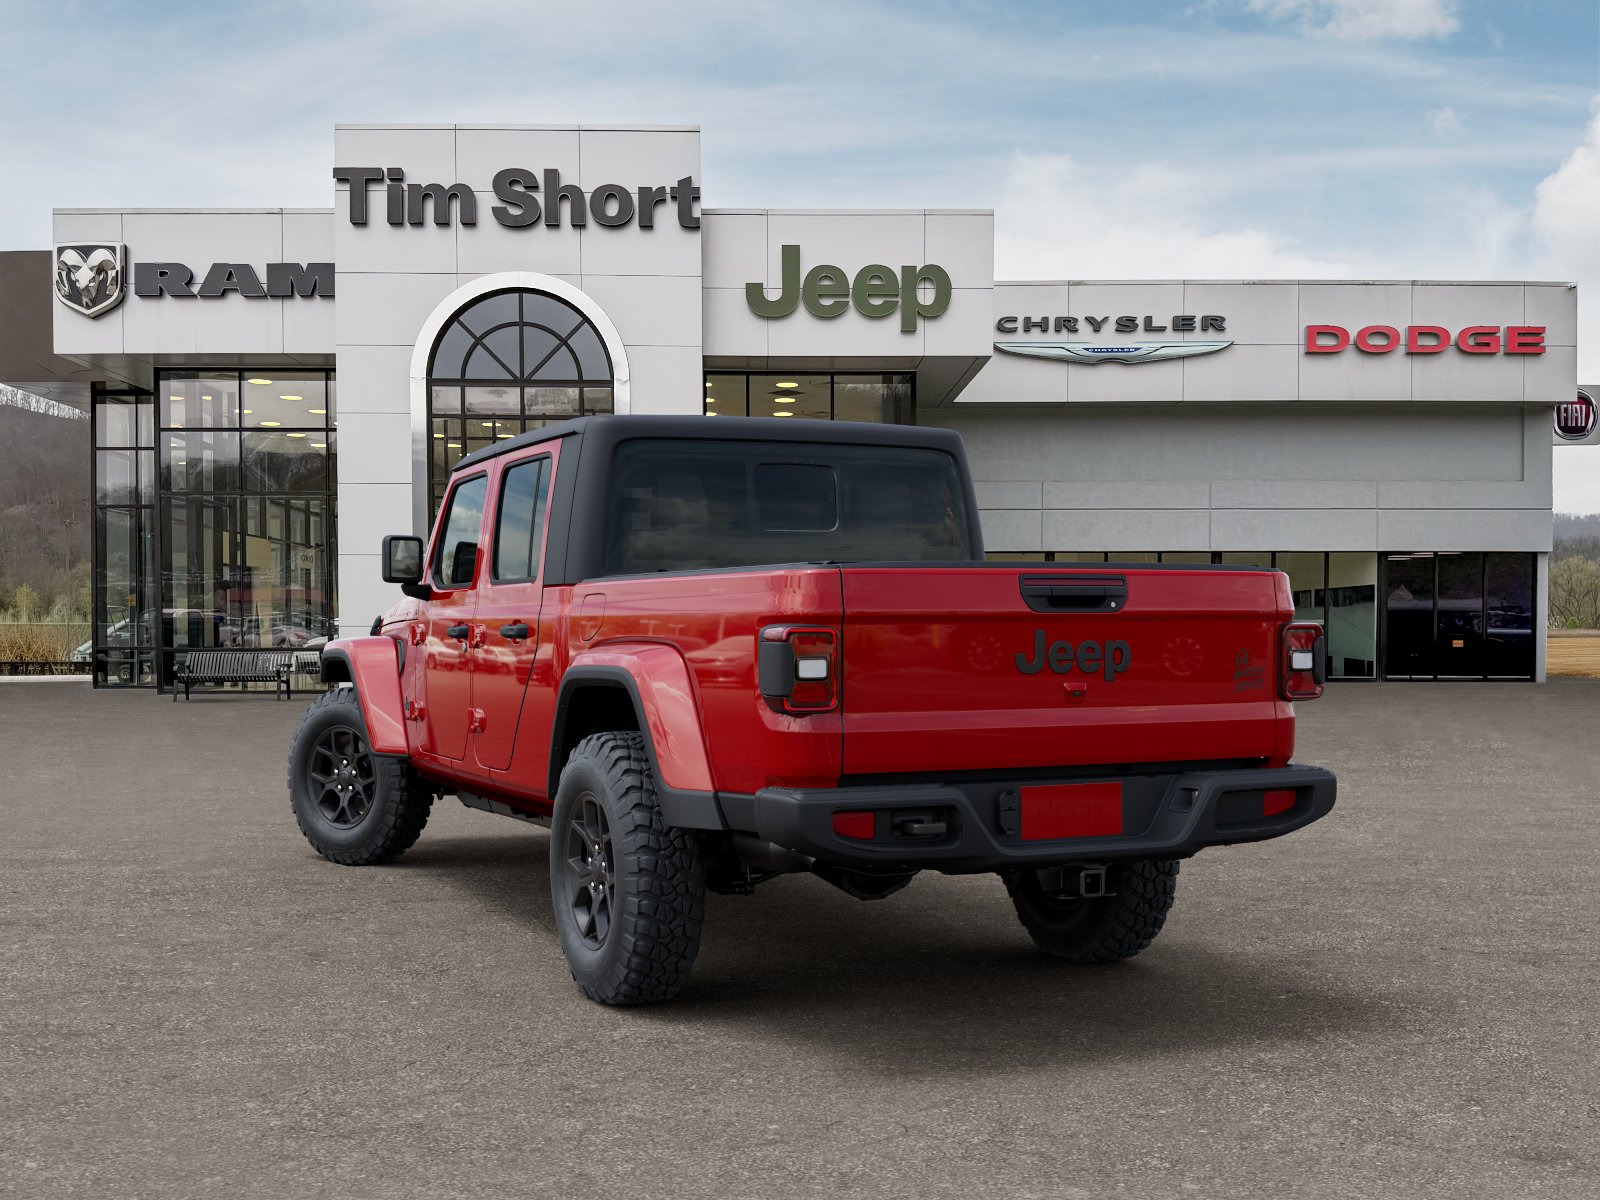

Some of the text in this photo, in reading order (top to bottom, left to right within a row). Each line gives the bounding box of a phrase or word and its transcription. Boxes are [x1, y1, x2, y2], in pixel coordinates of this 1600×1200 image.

[332, 167, 701, 229] Tim Short
[134, 262, 336, 298] RAM
[745, 244, 953, 333] Jeep
[997, 315, 1227, 333] CHRYSLER
[1304, 324, 1547, 355] DODGE
[1560, 404, 1586, 426] FIAT
[1015, 628, 1132, 682] Jeep
